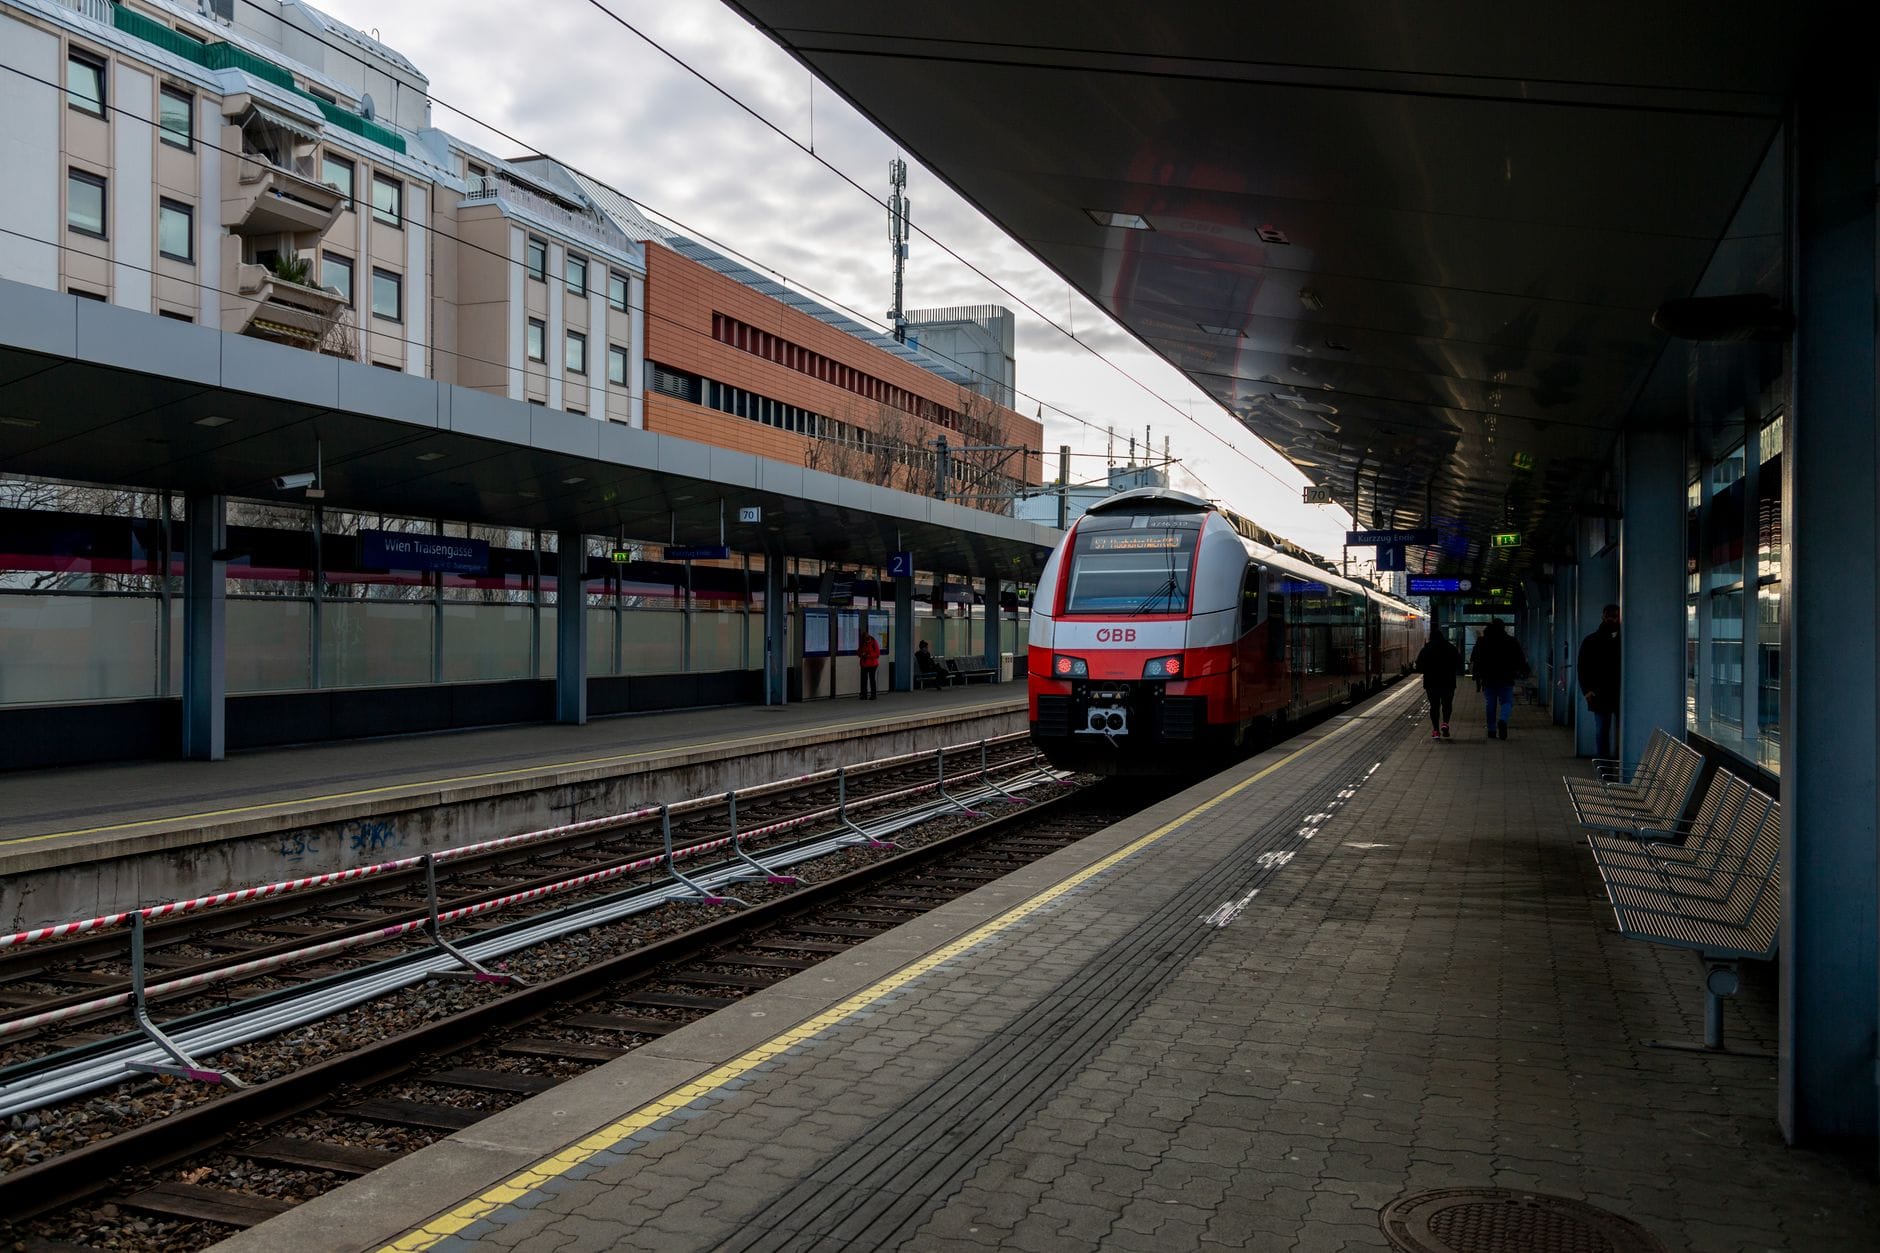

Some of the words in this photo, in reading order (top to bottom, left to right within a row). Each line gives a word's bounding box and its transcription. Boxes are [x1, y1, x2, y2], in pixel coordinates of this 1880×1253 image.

[1311, 490, 1326, 500] 70
[743, 510, 754, 520] 70
[1358, 533, 1391, 544] Kurzzug
[1394, 532, 1416, 542] Ende
[384, 538, 411, 553] Wien
[414, 540, 474, 559] Traisengasse
[892, 556, 904, 573] 2
[1385, 548, 1395, 567] 1
[1096, 627, 1137, 643] ÖBB
